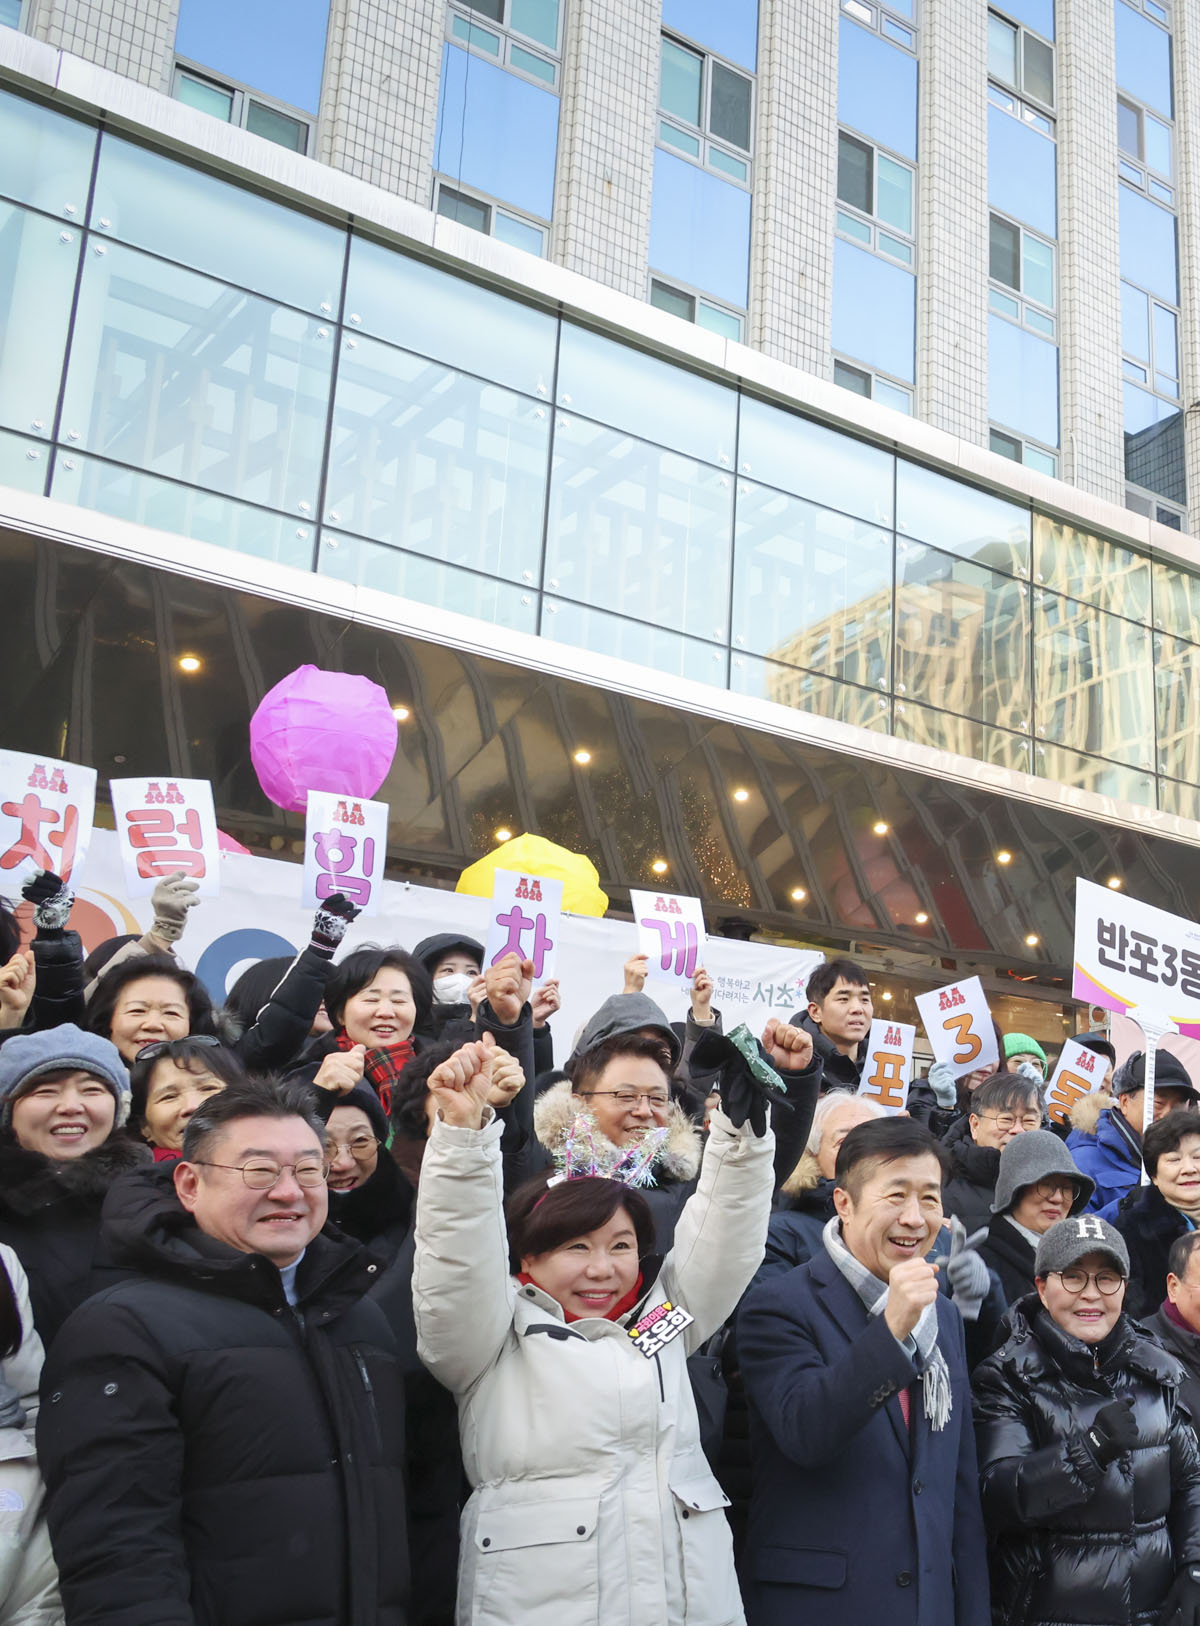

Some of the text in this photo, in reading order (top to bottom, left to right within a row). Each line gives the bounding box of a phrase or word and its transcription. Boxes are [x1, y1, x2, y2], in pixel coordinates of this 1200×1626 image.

[27, 773, 69, 795] 2026
[144, 791, 186, 804] 2026
[332, 810, 365, 826] 2026
[0, 792, 79, 884] 처
[125, 808, 206, 879] 럼
[313, 828, 375, 906] 힘
[515, 886, 543, 902] 2026
[491, 905, 553, 979] 차
[640, 918, 698, 979] 게
[752, 981, 795, 1008] 서초
[938, 994, 966, 1011] 2026
[943, 1013, 982, 1064] 3
[861, 1052, 906, 1107] 포
[1076, 1217, 1106, 1240] H
[633, 1305, 695, 1357] 조은희
[634, 1305, 668, 1332] 국회의원
